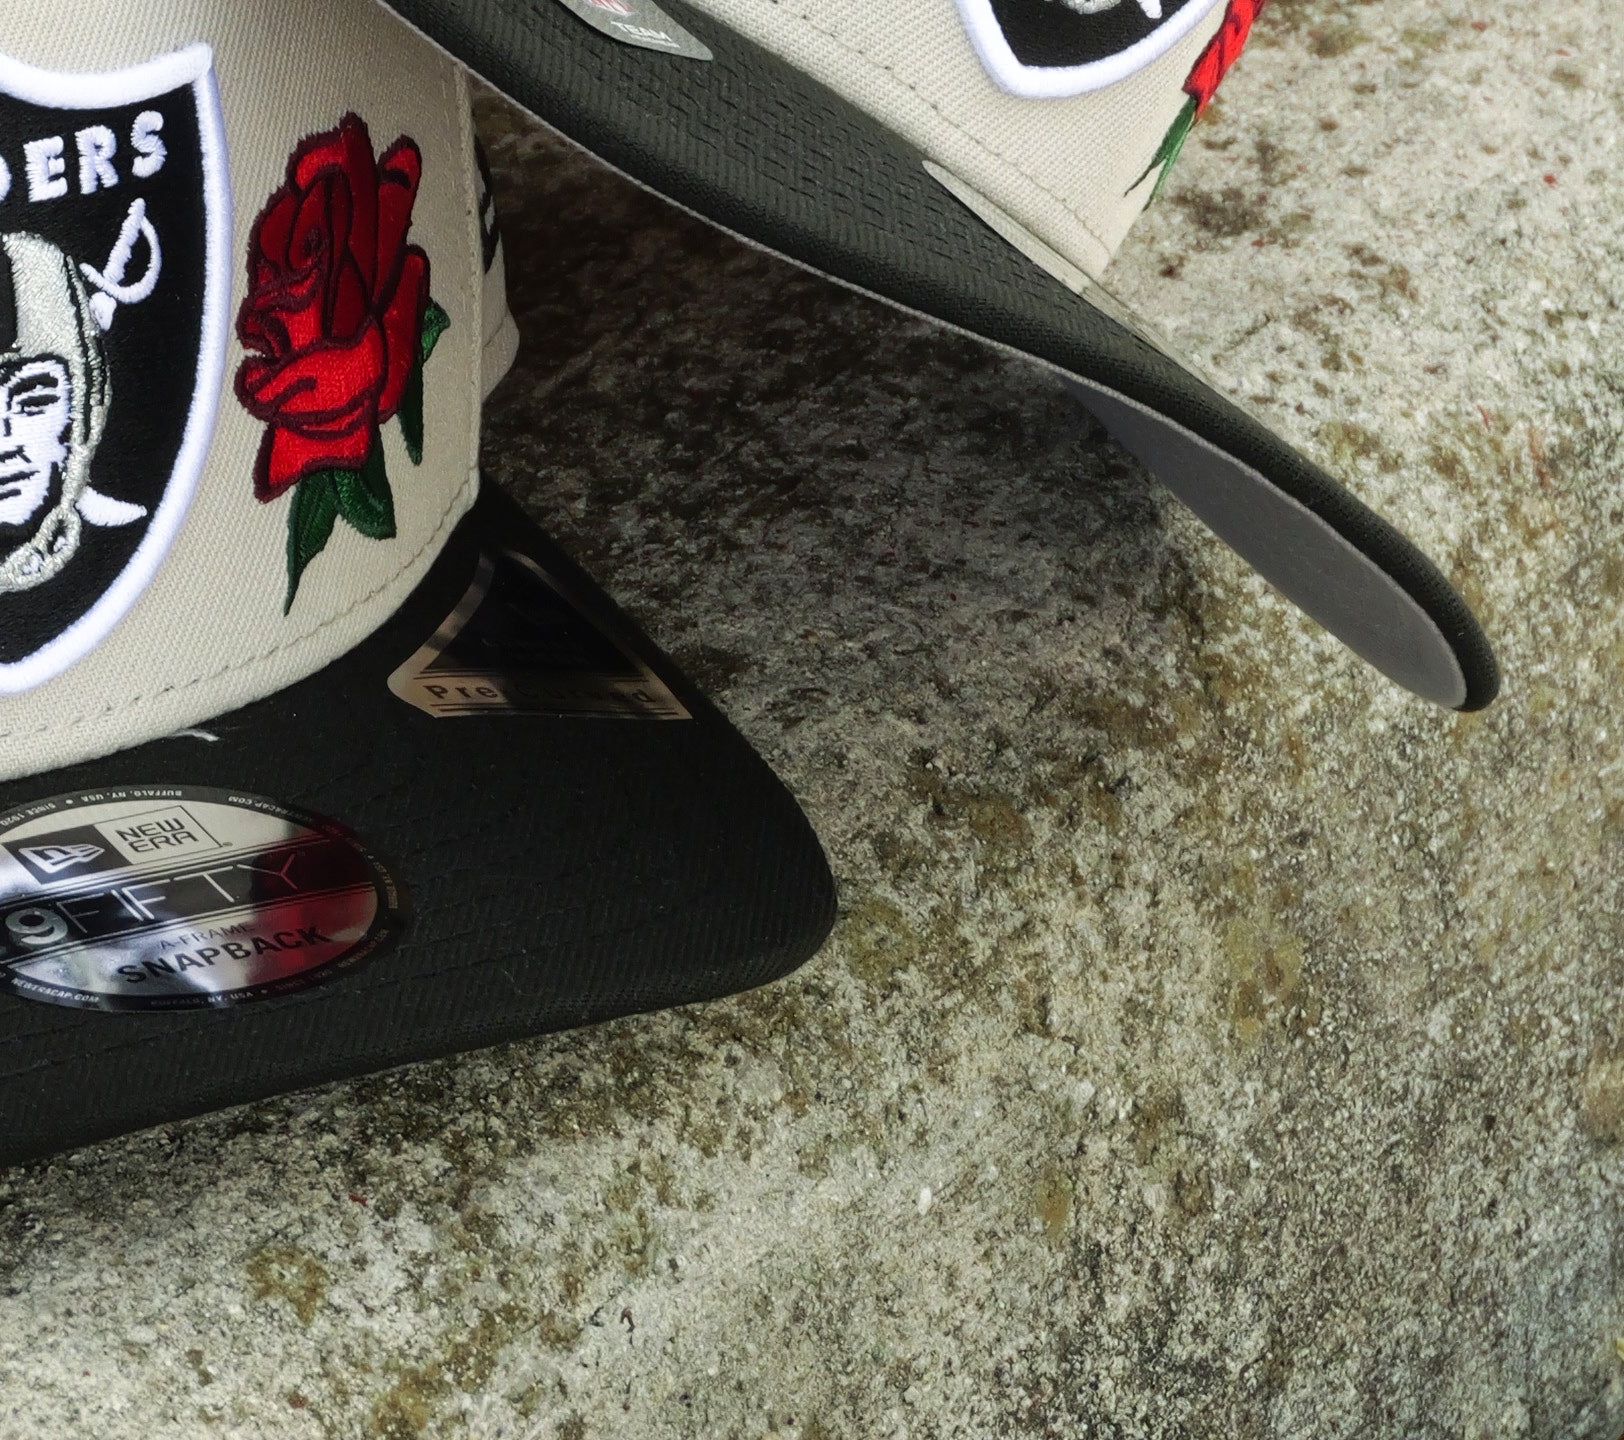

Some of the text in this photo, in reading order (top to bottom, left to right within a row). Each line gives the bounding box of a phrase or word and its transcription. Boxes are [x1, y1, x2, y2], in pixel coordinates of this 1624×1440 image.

[423, 684, 498, 700] Pre
[116, 817, 187, 842] NEW
[129, 830, 199, 853] ERA
[5, 854, 298, 948] 9FIFTY
[117, 924, 333, 985] SNAPBACK
